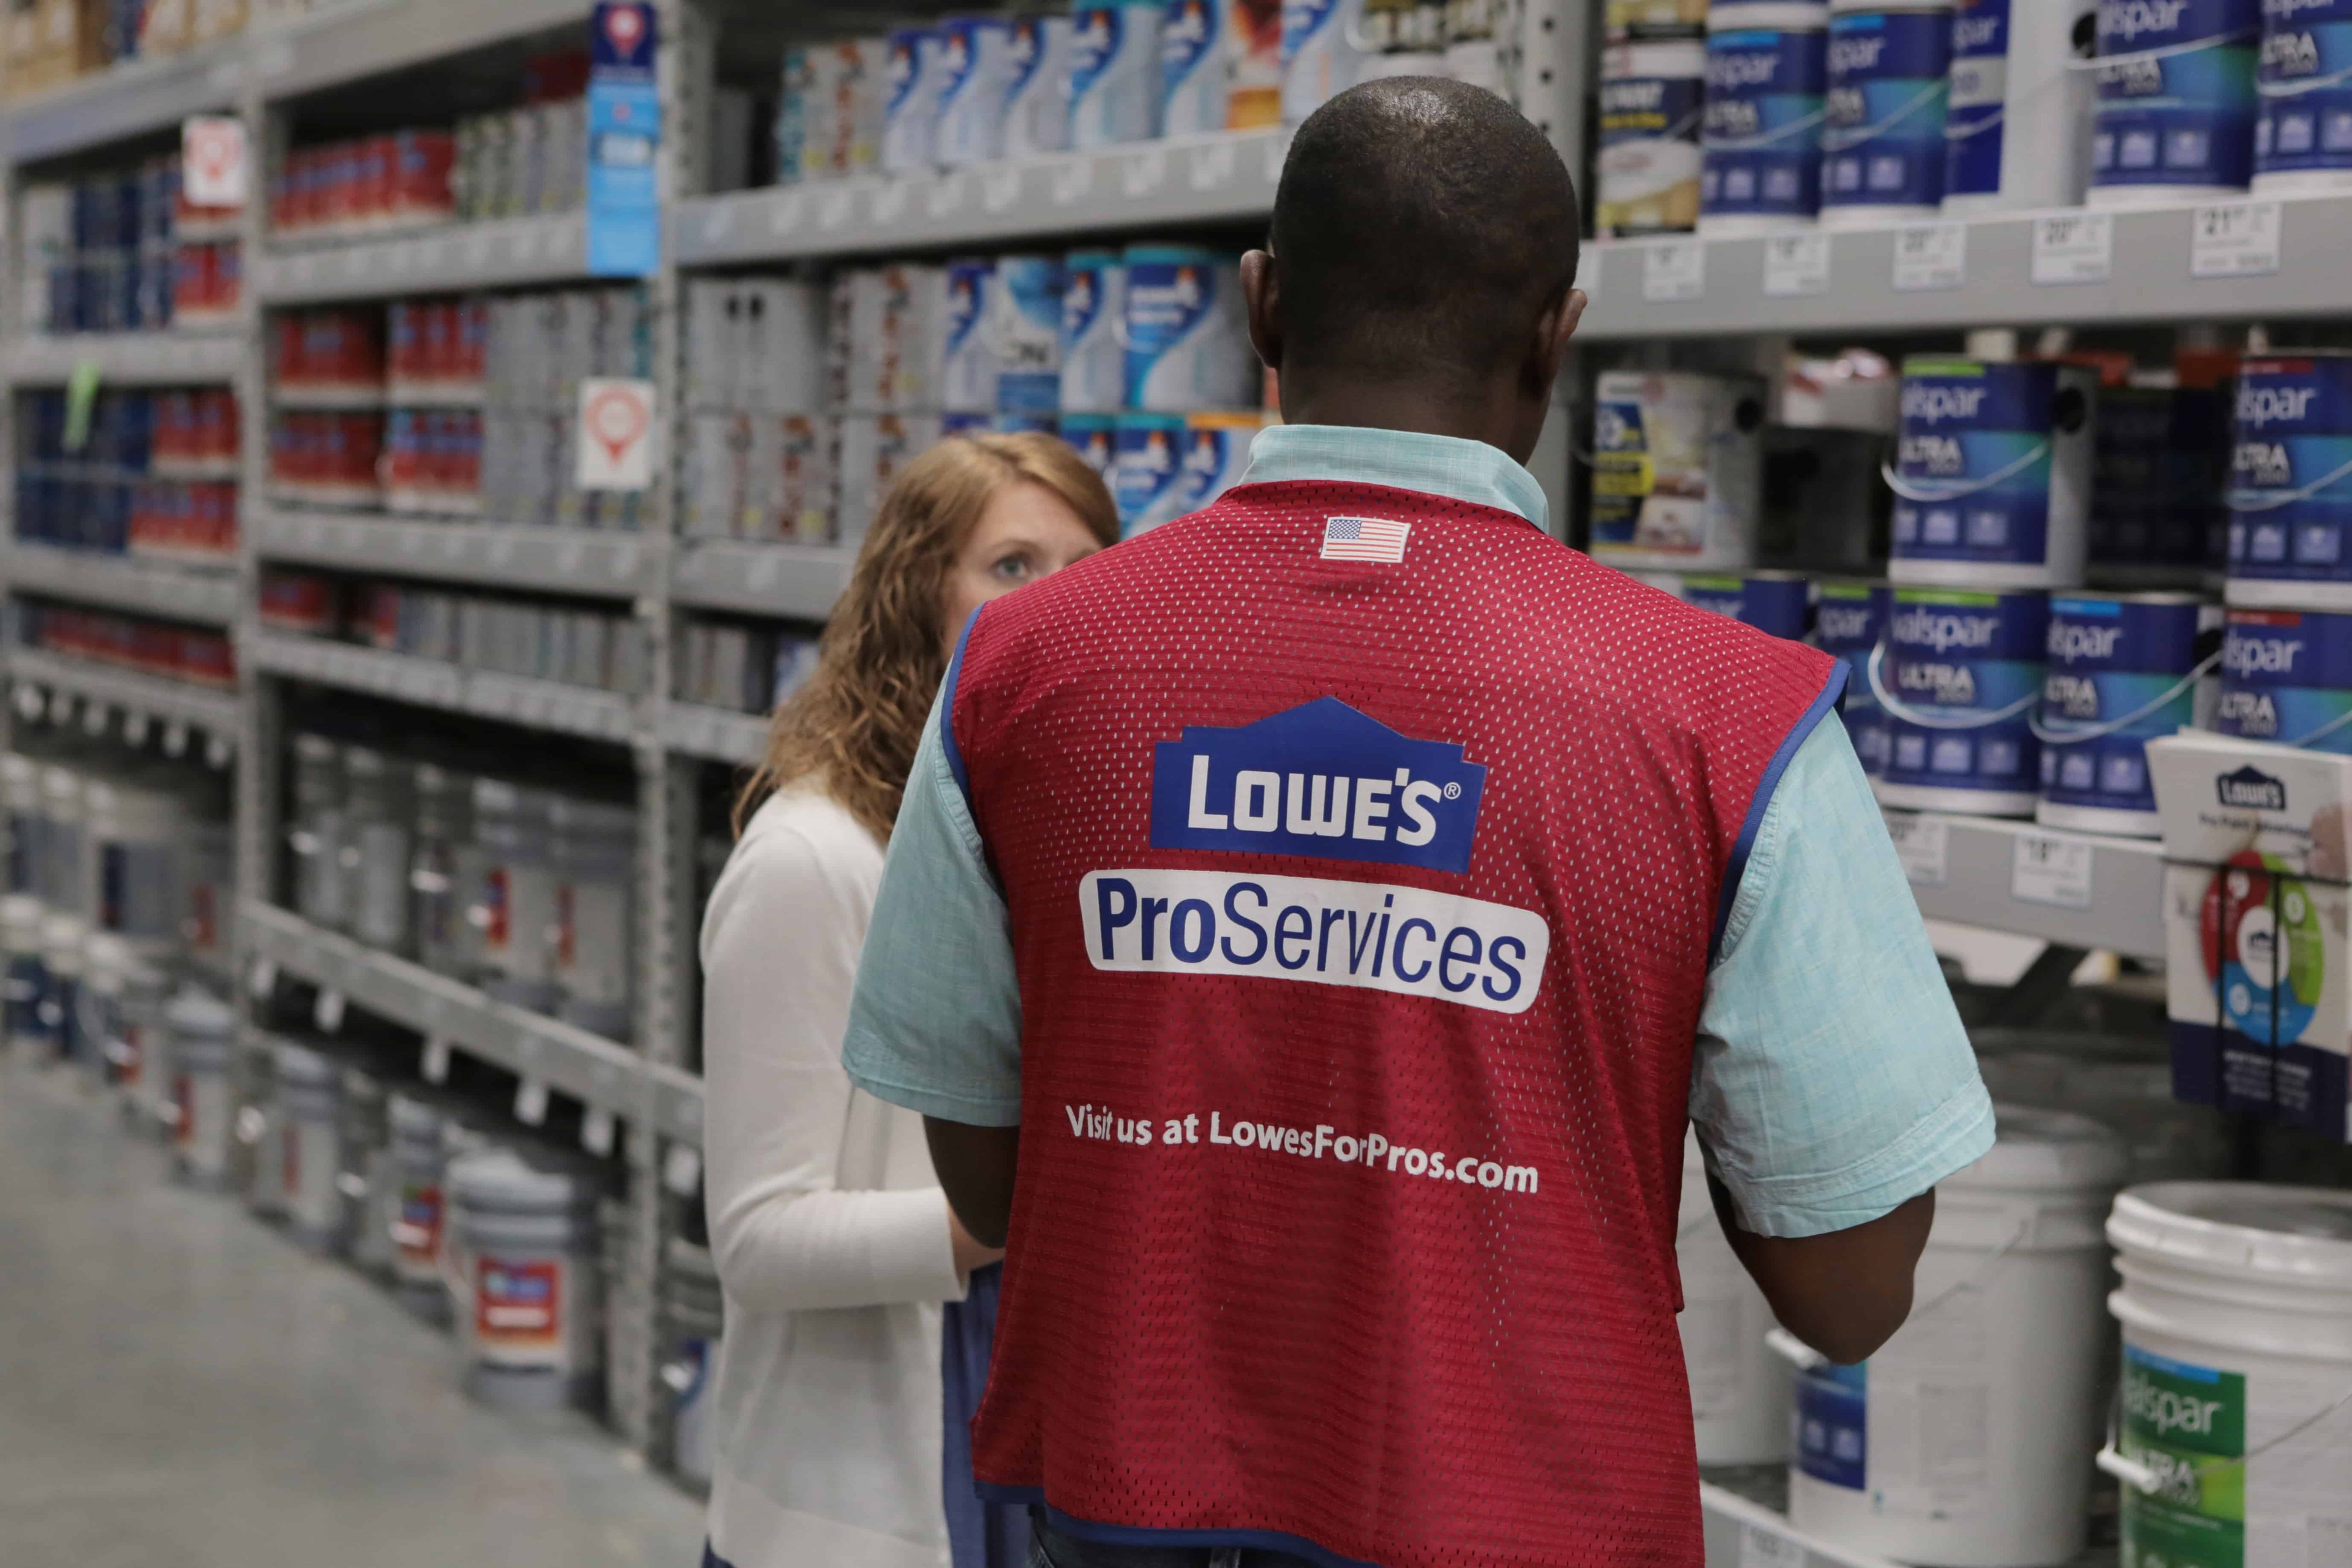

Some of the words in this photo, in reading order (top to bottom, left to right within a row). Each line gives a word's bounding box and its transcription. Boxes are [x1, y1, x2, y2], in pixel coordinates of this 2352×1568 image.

[1096, 876, 1526, 1001] ProServices
[1065, 1104, 1113, 1140] Visit
[1118, 1117, 1152, 1145] us
[1163, 1112, 1199, 1145] at
[1210, 1111, 1539, 1194] LowesForPros.com
